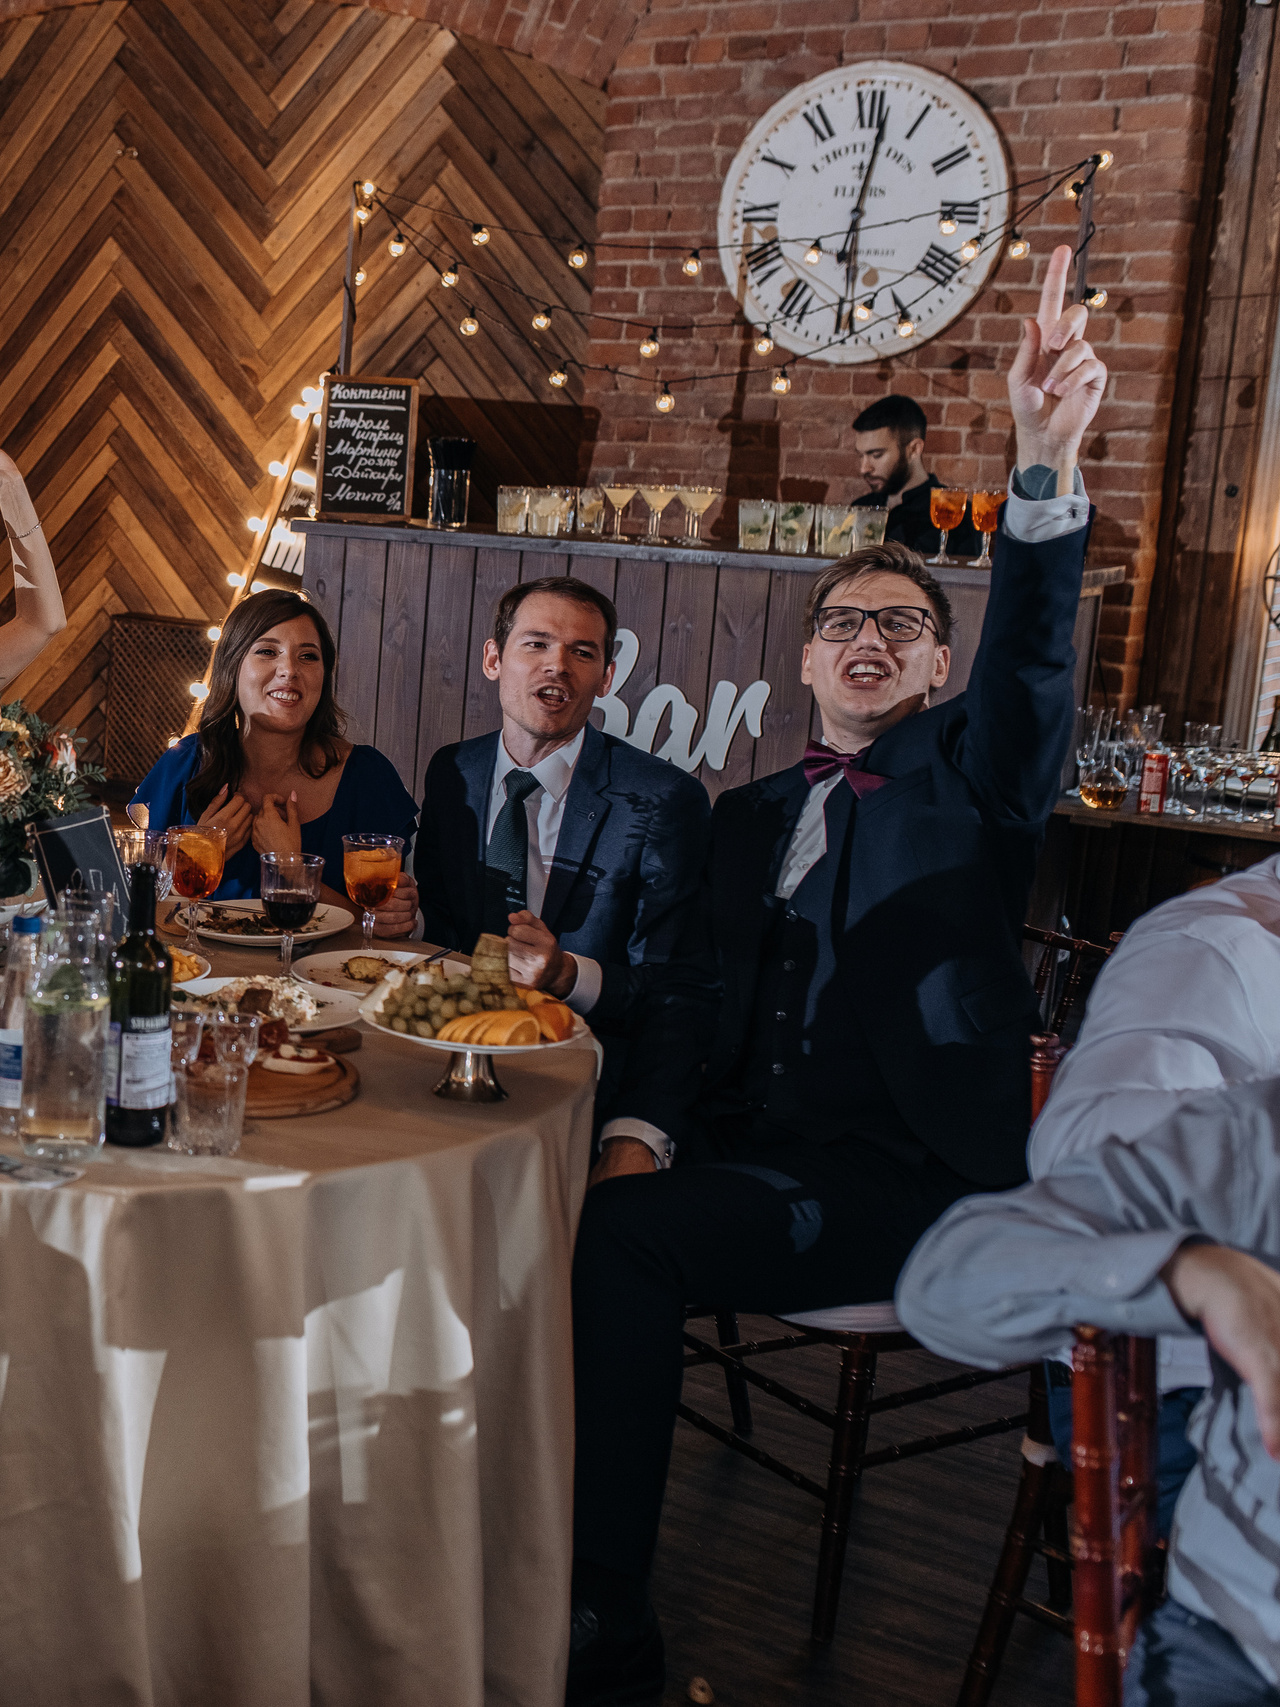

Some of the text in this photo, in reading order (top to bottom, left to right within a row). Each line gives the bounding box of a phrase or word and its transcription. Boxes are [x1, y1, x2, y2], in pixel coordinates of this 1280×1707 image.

[802, 103, 836, 147] XI
[931, 144, 971, 177] II
[330, 383, 406, 400] Коктейли
[353, 456, 398, 474] рояль
